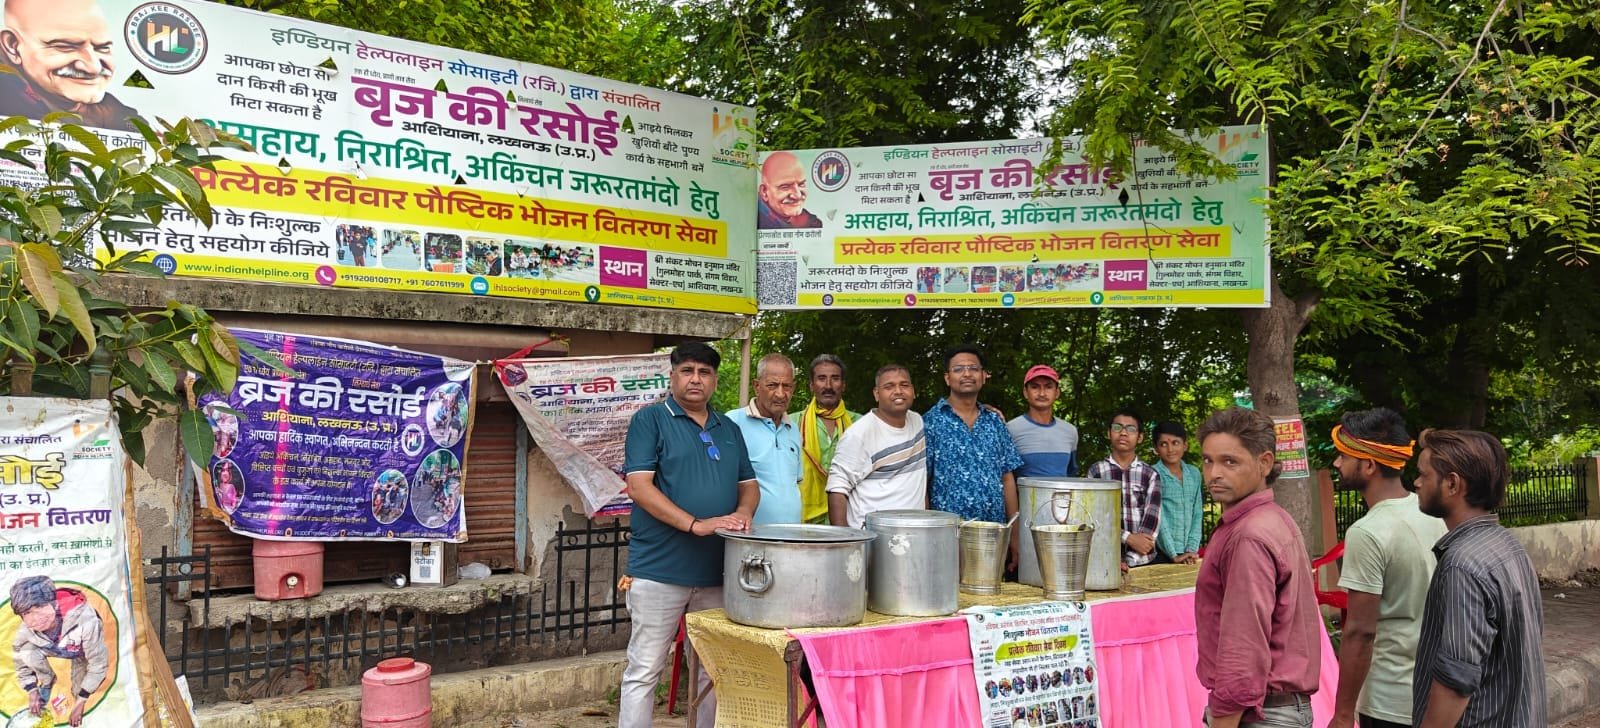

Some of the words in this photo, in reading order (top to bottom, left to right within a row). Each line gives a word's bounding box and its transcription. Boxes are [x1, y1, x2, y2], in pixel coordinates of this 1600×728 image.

[131, 9, 148, 27] BRAJ
[173, 9, 201, 38] RASOEE
[224, 53, 274, 72] आपका
[278, 61, 311, 78] छोटा
[270, 28, 351, 55] इण्डियन
[355, 40, 444, 72] हेल्पलाइन
[447, 59, 518, 86] सोसाइटी
[523, 75, 566, 96] (रजि.)
[570, 84, 598, 101] द्वारा
[602, 89, 661, 113] संचालित
[216, 72, 244, 86] दान
[248, 76, 285, 95] किसी
[289, 82, 309, 97] की
[312, 87, 338, 104] भूख
[230, 93, 262, 109] मिटा
[265, 98, 309, 117] सकता
[312, 104, 323, 121] है
[351, 76, 437, 127] बृज
[446, 86, 510, 130] की
[517, 102, 620, 156] रसोई
[401, 120, 484, 145] आशियाना,
[487, 134, 551, 153] लखनऊ
[555, 142, 596, 162] (उ.प्र.)
[637, 122, 661, 134] आइये
[664, 124, 693, 140] मिलकर
[625, 152, 645, 163] कार्य
[646, 153, 656, 165] के
[657, 157, 689, 171] सहभागी
[681, 145, 700, 157] पुण्य
[883, 147, 929, 162] इण्डियन
[931, 146, 988, 159] हेल्पलाइन
[991, 142, 1042, 156] सोसाइटी
[200, 118, 326, 163] सहाय,
[335, 129, 457, 179] निराश्रित,
[465, 152, 564, 191] अकिंचन
[569, 170, 680, 207] जरूरतमंदो
[689, 181, 720, 220] हेतु
[858, 171, 885, 180] आपका
[887, 170, 905, 180] छोटा
[906, 171, 917, 179] सा
[928, 168, 983, 201] बृज
[989, 158, 1035, 189] की
[855, 185, 868, 193] दान
[871, 183, 891, 192] किसी
[892, 182, 903, 191] की
[959, 191, 1015, 201] आशियाना,
[191, 165, 298, 197] प्रत्येक
[304, 176, 408, 210] रविवार
[414, 185, 514, 220] पौष्टिक
[519, 200, 588, 230] भोजन
[594, 208, 670, 240] वितरण
[675, 219, 718, 245] सेवा
[861, 195, 878, 205] मिटा
[879, 195, 903, 204] सकता
[225, 209, 245, 226] के
[249, 211, 321, 236] निःशुल्क
[844, 212, 912, 231] असहाय,
[918, 205, 995, 228] निराश्रित,
[1001, 203, 1077, 225] अकिंचन
[1081, 199, 1182, 222] जरूरतमंदो
[1191, 198, 1223, 226] हेतु
[165, 228, 194, 253] हेतु
[198, 232, 265, 254] सहयोग
[270, 237, 330, 260] कीजिये
[841, 239, 896, 256] प्रत्येक
[900, 236, 962, 255] रविवार
[965, 235, 1036, 254] पौष्टिक
[1040, 233, 1096, 252] भोजन
[1101, 231, 1171, 250] वितरण
[1178, 229, 1221, 248] सेवा
[184, 263, 310, 281] www.indianhelpline.org
[603, 258, 644, 277] स्थान
[665, 256, 683, 266] संकट
[685, 258, 702, 268] मोचन
[704, 262, 725, 272] हनुमान
[808, 265, 855, 276] जरूरतमंदो
[857, 265, 868, 275] के
[1107, 268, 1144, 282] स्थान
[800, 279, 826, 290] भोजन
[828, 279, 842, 292] हेतु
[844, 279, 878, 290] सहयोग
[880, 278, 913, 290] कीजिये
[237, 375, 295, 407] ब्रज
[298, 376, 346, 410] की
[348, 384, 425, 419] रसोई
[529, 383, 577, 399] ब्रज
[581, 376, 617, 394] की
[621, 373, 671, 392] रसो
[262, 409, 316, 428] आशियाना,
[317, 417, 363, 431] लखनऊ
[15, 434, 62, 445] संचालित
[248, 429, 277, 441] आपका
[278, 429, 303, 443] हार्दिक
[371, 438, 394, 451] करती
[0, 452, 67, 490] सोई
[27, 491, 51, 506] प्र.)
[0, 511, 41, 529] ोजन
[46, 508, 112, 527] वितरण
[9, 560, 22, 569] का
[58, 554, 81, 565] करती
